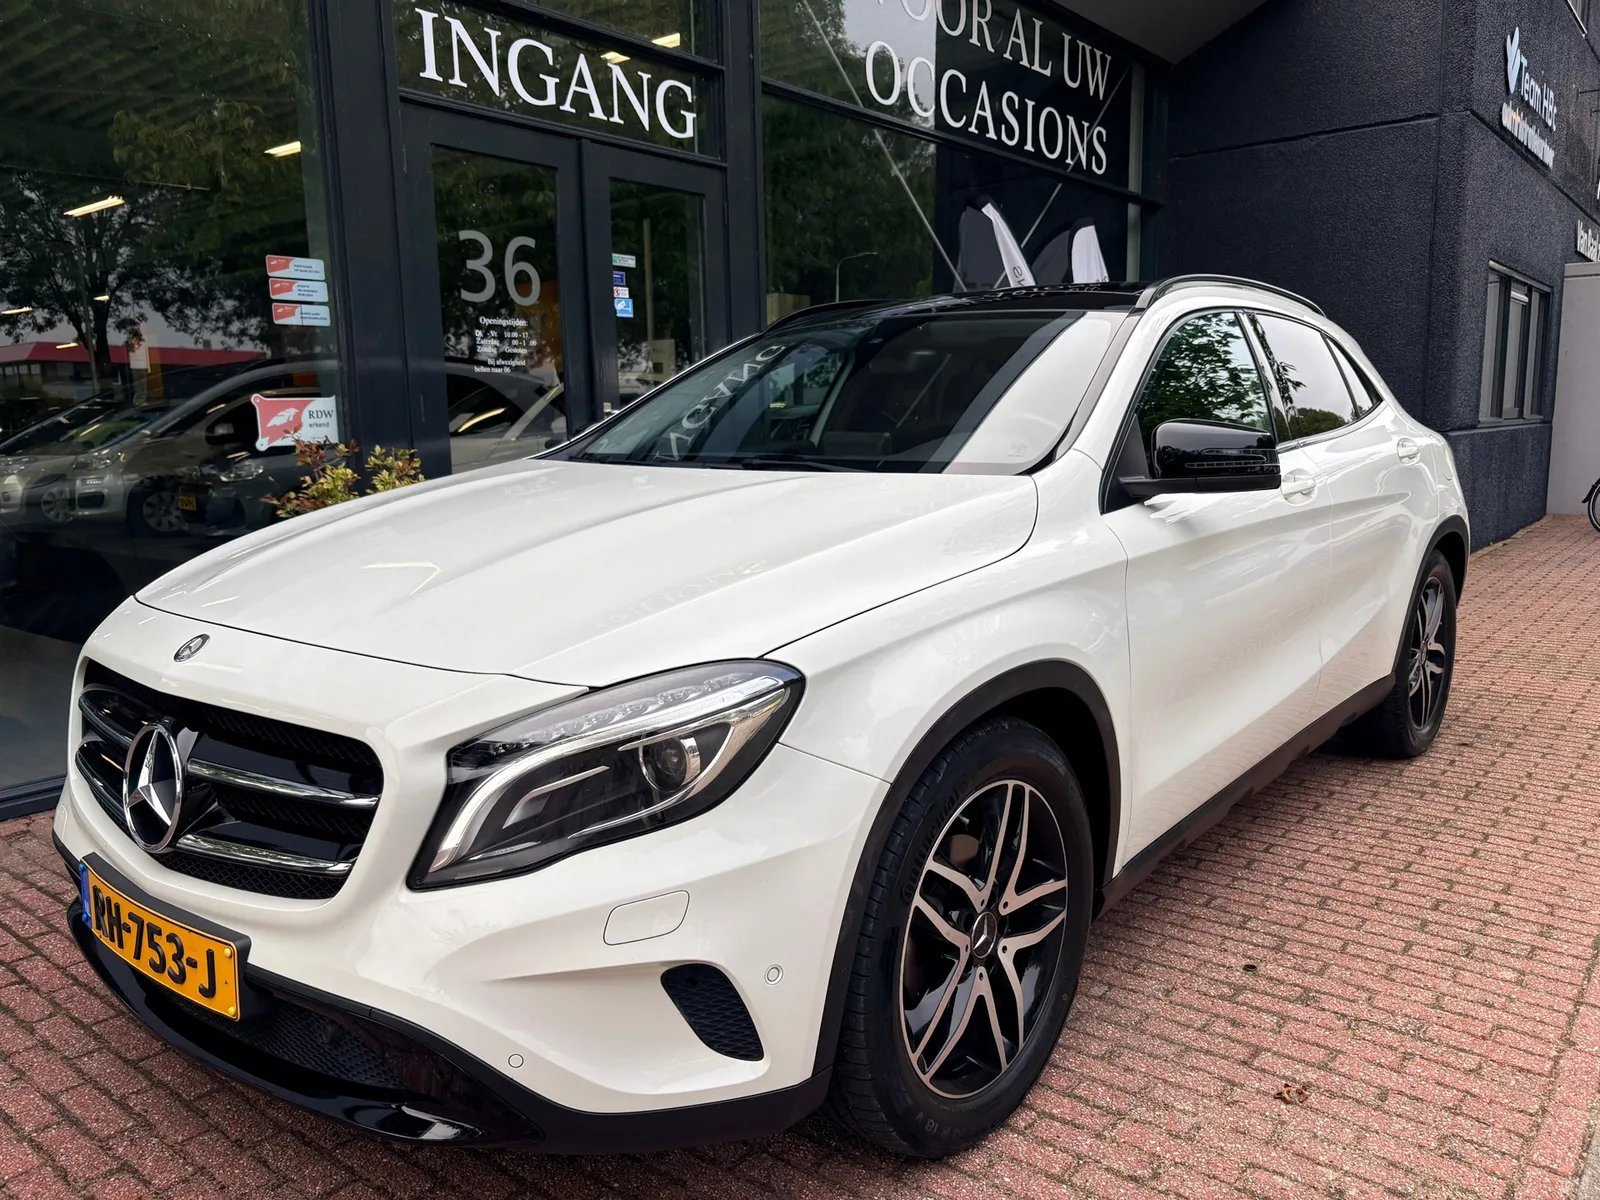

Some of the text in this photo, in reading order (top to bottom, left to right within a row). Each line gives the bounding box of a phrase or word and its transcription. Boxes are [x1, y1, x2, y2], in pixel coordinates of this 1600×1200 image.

[415, 7, 697, 139] INGANG
[878, 0, 1112, 101] OR AL UW
[1520, 54, 1541, 115] Team
[865, 40, 1107, 175] OCCASIONS
[458, 229, 541, 306] 36
[475, 337, 500, 347] Zaterdag
[479, 316, 528, 328] Openingstijden:
[308, 409, 334, 420] RDW
[92, 885, 217, 999] RH-753-J
